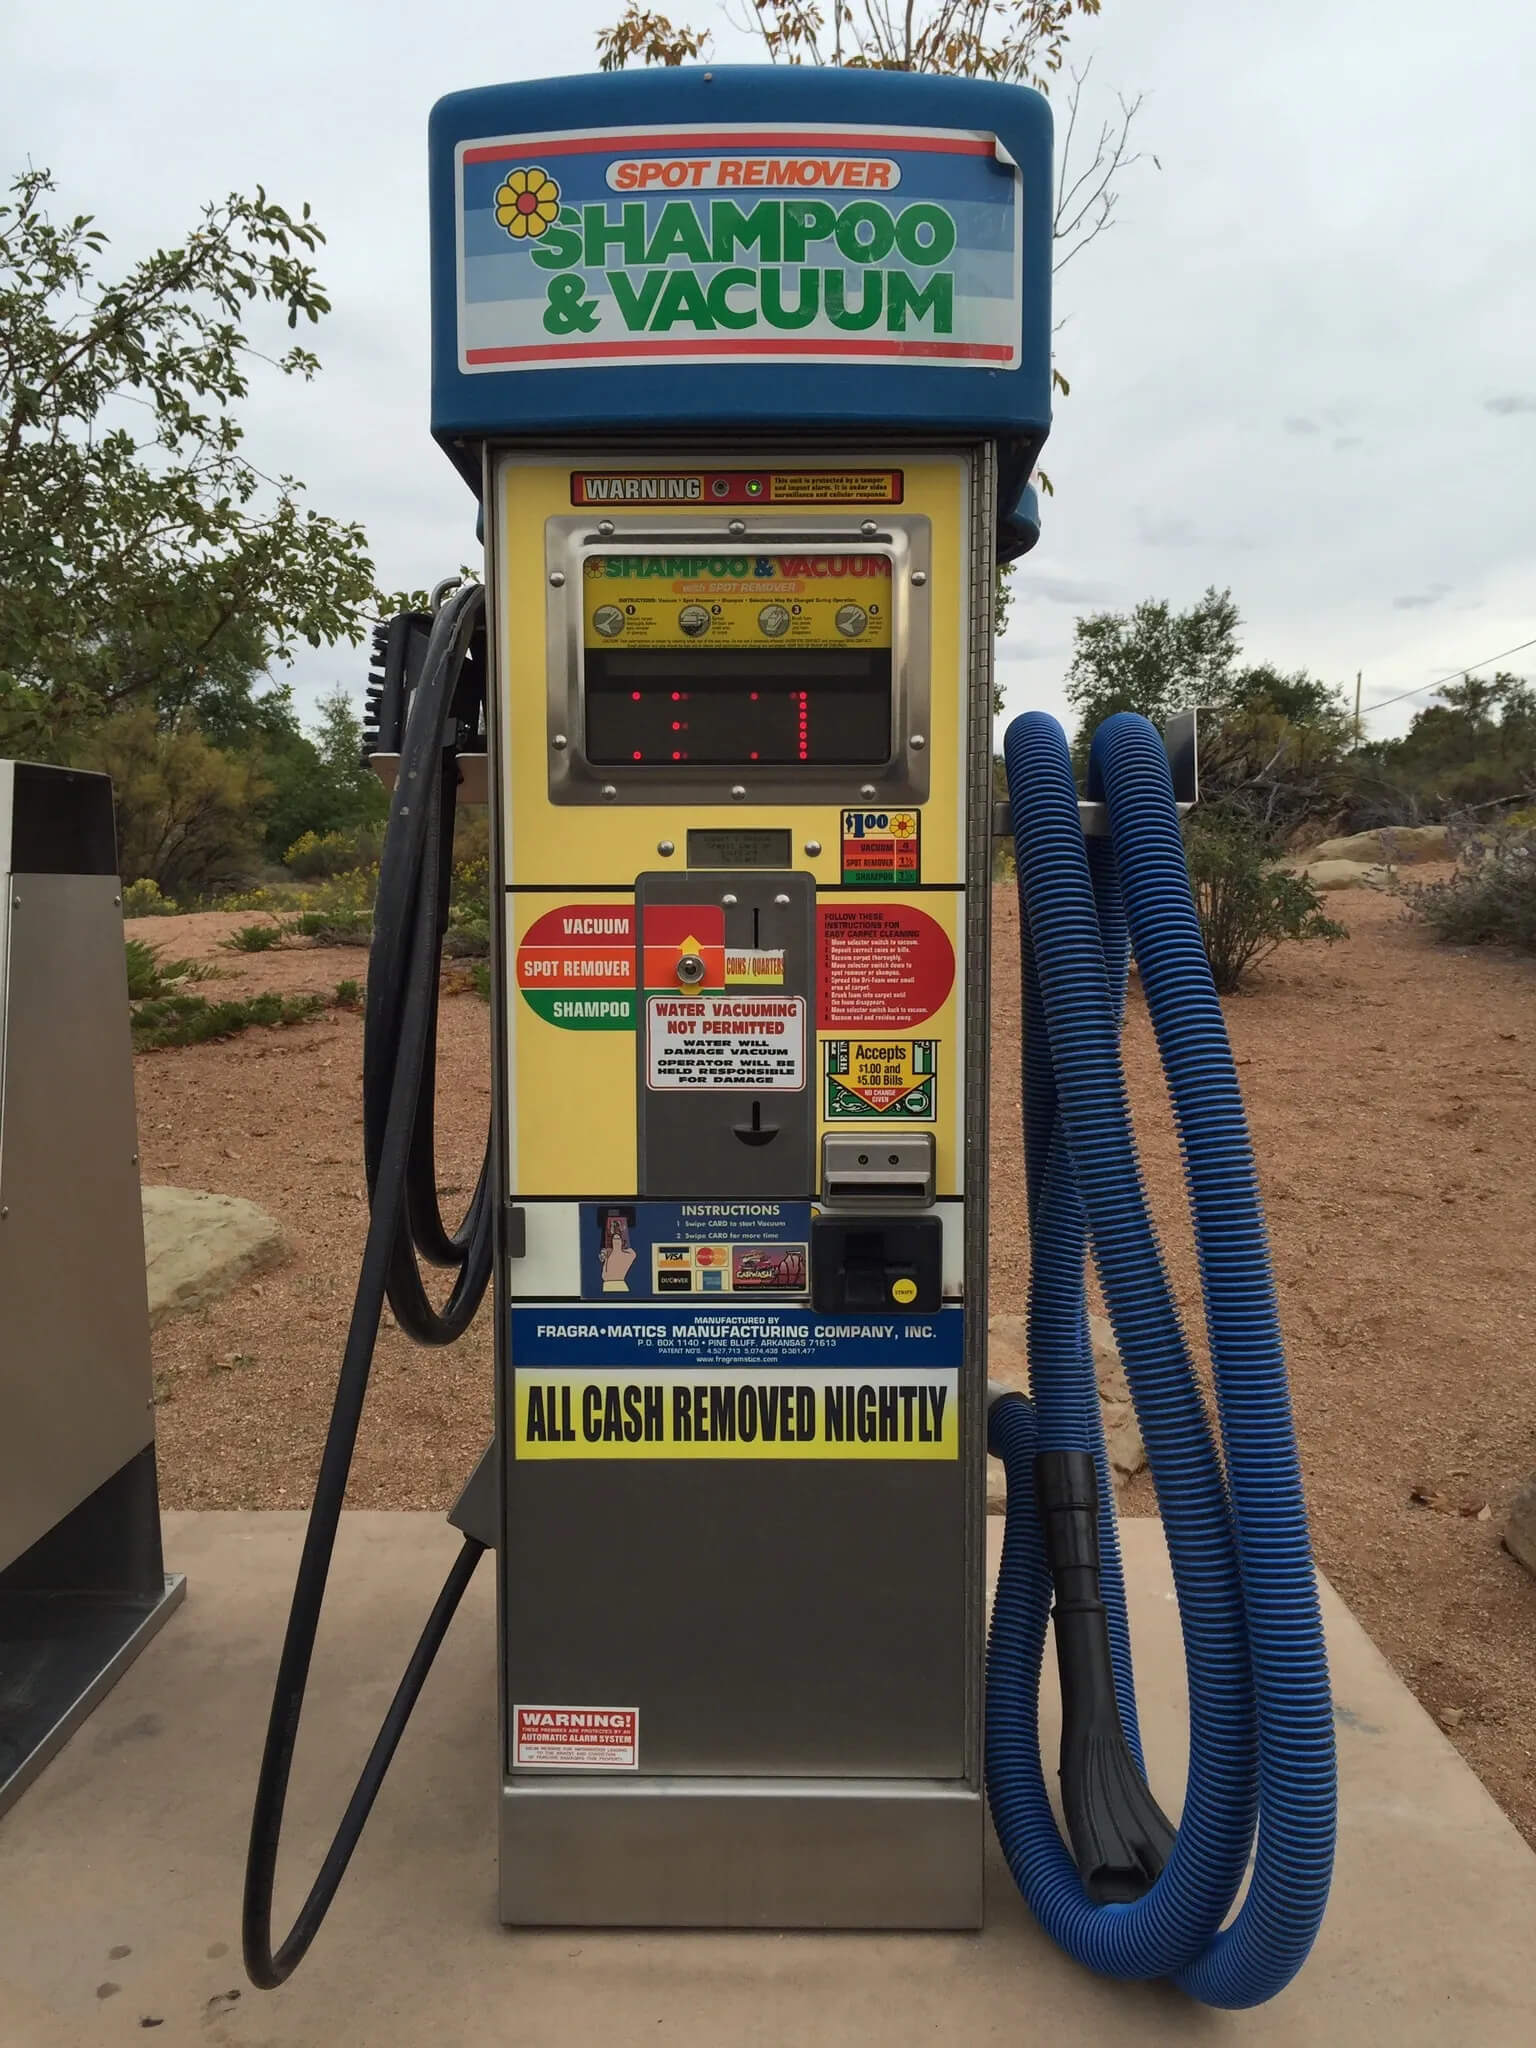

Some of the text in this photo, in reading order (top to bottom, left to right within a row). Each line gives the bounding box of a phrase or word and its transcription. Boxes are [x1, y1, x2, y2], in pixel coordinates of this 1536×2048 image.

[614, 161, 892, 188] SPOT REMOVER
[531, 200, 956, 270] SHAMPOO
[543, 267, 952, 334] & VACUUM
[586, 478, 700, 498] WARNING
[606, 556, 891, 577] SHAMPOO & VACUUM
[683, 583, 795, 592] with SPOT REMOVER
[846, 859, 893, 867] SPOT REMOVER
[856, 872, 893, 881] SHAMPOO
[563, 919, 629, 934] VACUUM
[524, 961, 630, 977] SPOT REMOVER
[727, 957, 746, 975] COINS
[554, 1002, 630, 1017] SHAMPOO
[656, 1004, 797, 1017] WATER VACUUMING
[668, 1022, 785, 1035] NOT PERMITTED
[856, 1045, 906, 1062] Accepts
[859, 1064, 900, 1073] $1.00 and
[858, 1075, 903, 1085] $5.00 Bills
[682, 1205, 780, 1216] INSTRUCTIONS
[685, 1220, 705, 1228] Swipe
[685, 1232, 706, 1240] Swipe
[672, 1326, 808, 1337] MANUFACTURING
[815, 1326, 898, 1340] COMPANY,
[905, 1326, 937, 1337] INC.
[526, 1386, 948, 1442] ALL CASH REMOVED NIGHTLY
[522, 1713, 631, 1727] WARNING!
[522, 1734, 631, 1744] AUTOMATIC ALARM SYSTEM
